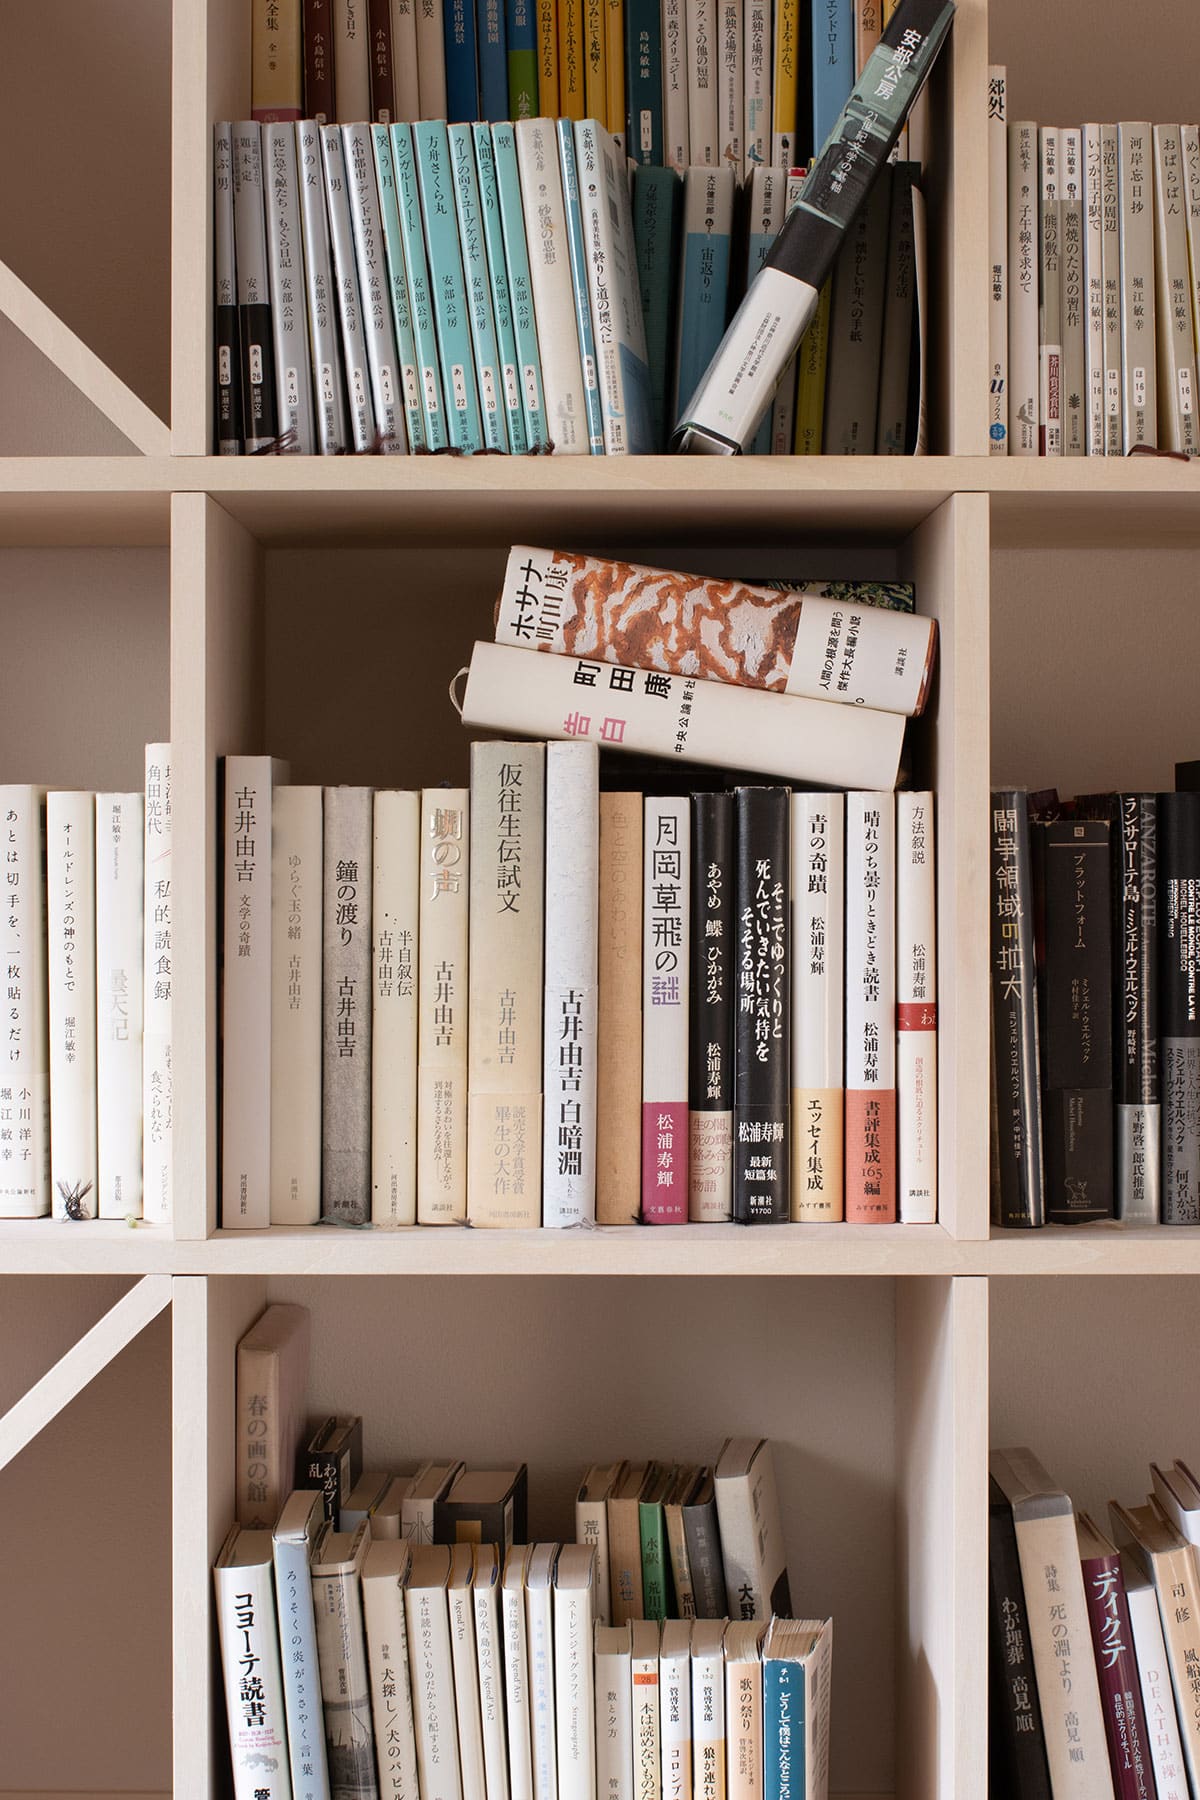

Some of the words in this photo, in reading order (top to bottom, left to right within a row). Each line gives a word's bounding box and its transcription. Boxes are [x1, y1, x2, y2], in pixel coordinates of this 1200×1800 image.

[313, 33, 325, 81] 小島信夫
[376, 29, 388, 77] 小島信夫
[640, 31, 650, 79] 島尾敏雄
[724, 6, 737, 74] 孤独な場所で
[752, 6, 764, 77] 孤独な場所で
[873, 29, 922, 100] 安部公房
[988, 78, 1005, 122] 郊外へ
[216, 137, 230, 192] 飛ぶ男
[240, 137, 253, 183] 題未定
[303, 134, 318, 188] 砂の女
[326, 138, 342, 192] 箱男
[376, 136, 394, 188] 笑う月
[479, 136, 495, 210] 人間そっくり
[498, 135, 512, 149] 壁
[532, 128, 545, 172] 安部公房
[582, 128, 595, 172] 安部公房
[830, 111, 878, 194] 21世紀文学の基軸
[1020, 128, 1031, 173] 堀江敏幸
[1046, 137, 1055, 176] 堀江敏幸
[1066, 137, 1076, 176] 堀江敏幸
[272, 137, 294, 269] 死に急ぐ鯨たち・もぐら日記
[352, 136, 377, 270] 水中都市・デンドロカカリヤ
[397, 137, 416, 232] カンガルー・ノート
[427, 135, 448, 216] 方舟さくら丸
[454, 137, 480, 262] カーブの向う・ユープケッチャ
[705, 175, 715, 214] 大江健三郎
[763, 175, 773, 214] 大江健三郎
[1088, 139, 1100, 230] いつか王子駅で
[1103, 139, 1117, 232] 雪沼とその周辺
[1130, 136, 1144, 215] 河岸忘日抄
[1164, 138, 1181, 215] おぱらばん
[538, 204, 556, 265] 砂漠の思想
[700, 247, 714, 288] 宙返り
[1019, 204, 1032, 294] 子午線を求めて
[1045, 214, 1058, 272] 熊の敷石
[314, 274, 328, 328] 安部公房
[393, 276, 409, 328] 安部公房
[442, 275, 458, 328] 安部公房
[495, 276, 509, 328] 安部公房
[514, 276, 530, 329] 安部公房
[592, 250, 612, 344] 終りし道の標べに
[850, 241, 866, 343] 懐かしい年への手紙
[992, 265, 1002, 302] 堀江敏幸
[1066, 212, 1080, 327] 燃焼のための習作
[280, 278, 294, 332] 安部公房
[343, 278, 357, 332] 安部公房
[368, 276, 384, 330] 安部公房
[413, 278, 428, 331] 安部公房
[472, 278, 486, 331] 安部公房
[1090, 278, 1101, 330] 堀江敏幸
[1106, 280, 1117, 332] 堀江敏幸
[1132, 278, 1144, 330] 堀江敏幸
[1173, 279, 1187, 332] 堀江敏幸
[510, 558, 544, 640] ホサナ
[536, 568, 569, 642] 町田康
[573, 660, 672, 700] 町田康
[819, 610, 844, 691] 人間の根源を問う
[837, 615, 862, 692] 傑作大長編小説
[563, 712, 626, 744] 告白
[674, 680, 697, 754] 中央公論新社
[112, 804, 121, 843] 堀江敏幸
[147, 764, 162, 834] 角田光代
[234, 786, 256, 882] 古井由吉
[429, 808, 464, 901] 蜩の声
[496, 764, 523, 914] 仮往生伝試文
[808, 814, 828, 894] 青の奇蹟
[912, 806, 926, 864] 方法叙説
[1122, 798, 1140, 904] ランサローテ島
[1140, 798, 1157, 928] LANZAROTE
[63, 823, 76, 991] オールドレンズの神のもとで
[288, 855, 302, 940] ゆらぐ玉の緒
[336, 860, 359, 947] 鐘の渡り
[652, 815, 682, 1006] 月岡草飛の謎
[706, 862, 722, 910] あやめ
[863, 810, 880, 1002] 晴れのち曇りときどき読書
[993, 809, 1024, 1000] 闘争領域の拡大
[1074, 852, 1086, 948] プラットフォーム
[1180, 879, 1188, 910] MICHEL
[1188, 879, 1196, 913] CONTRE
[1188, 914, 1196, 924] LE
[6, 810, 21, 1062] あとは切手を、一枚貼るだけ
[154, 880, 172, 1000] 私的読食録
[238, 895, 251, 957] 文学の奇蹟
[810, 916, 825, 976] 松浦寿輝
[1180, 912, 1188, 972] HOUELLEBECQ
[1188, 926, 1196, 959] MONDE,
[288, 954, 301, 1010] 古井由吉
[378, 930, 394, 997] 古井由吉
[396, 930, 415, 997] 半自叙伝
[706, 947, 723, 1005] ひかがみ
[740, 906, 754, 1014] そそる場所
[756, 858, 772, 1062] 死んでいきたい気持を
[770, 882, 786, 1038] そこでゆっくりと
[912, 944, 926, 1000] 松浦寿輝
[1125, 908, 1140, 1023] ミシェル・ウエルベック
[1188, 960, 1196, 994] CONTRE
[336, 976, 356, 1058] 古井由吉
[434, 960, 454, 1046] 古井由吉
[498, 988, 516, 1065] 古井由吉
[1081, 978, 1094, 1064] ミシェル・ウエルベック
[1188, 996, 1196, 1006] LA
[1188, 1007, 1196, 1020] VIE
[64, 1017, 76, 1064] 堀江敏幸
[558, 990, 584, 1092] 古井由吉
[706, 1042, 722, 1100] 松浦寿輝
[863, 1022, 879, 1083] 松浦寿輝
[1009, 1012, 1020, 1098] ミシェル・ウエルベック
[1140, 1038, 1158, 1104] Michel
[0, 1088, 12, 1161] 堀江敏幸
[18, 1088, 32, 1160] 小川洋子
[152, 1070, 163, 1143] 食べられない
[1176, 1048, 1186, 1145] ミシェル・ウエルベック
[494, 1106, 512, 1195] 畢生の大作
[512, 1106, 526, 1195] 読売文学賞受賞
[558, 1098, 583, 1176] 白暗淵
[656, 1114, 674, 1188] 松浦寿輝
[738, 1122, 784, 1143] 松浦寿輝
[750, 1156, 772, 1168] 最新
[808, 1100, 824, 1191] エッセイ集成
[862, 1102, 883, 1196] 書評集成165編
[1132, 1110, 1145, 1200] 平野啓一郎氏推薦
[744, 1169, 777, 1181] 短篇集
[750, 1195, 773, 1206] 新潮社
[908, 1190, 930, 1198] 講談社
[308, 1464, 323, 1479] 乱
[738, 1584, 756, 1620] 大野
[1044, 1564, 1061, 1592] 詩集
[478, 1599, 492, 1670] 島の水、島の火
[568, 1600, 578, 1701] ストレンジオグラフィ
[1002, 1596, 1025, 1664] わが埋葬
[1048, 1602, 1073, 1694] 死の淵より
[1092, 1567, 1127, 1670] ディクテ
[234, 1592, 268, 1728] コヨーテ読書
[287, 1570, 314, 1776] ろうそくの炎がささやく言葉
[419, 1596, 440, 1764] 本は読めないものだから心配するな
[608, 1690, 618, 1738] 数と夕方
[670, 1686, 680, 1722] 管啓次郎
[703, 1686, 714, 1722] 管啓次郎
[740, 1678, 753, 1732] 歌の祭り
[1012, 1676, 1035, 1732] 高見順
[1064, 1712, 1085, 1762] 高見順
[1114, 1692, 1133, 1769] 自伝的エクリチュール
